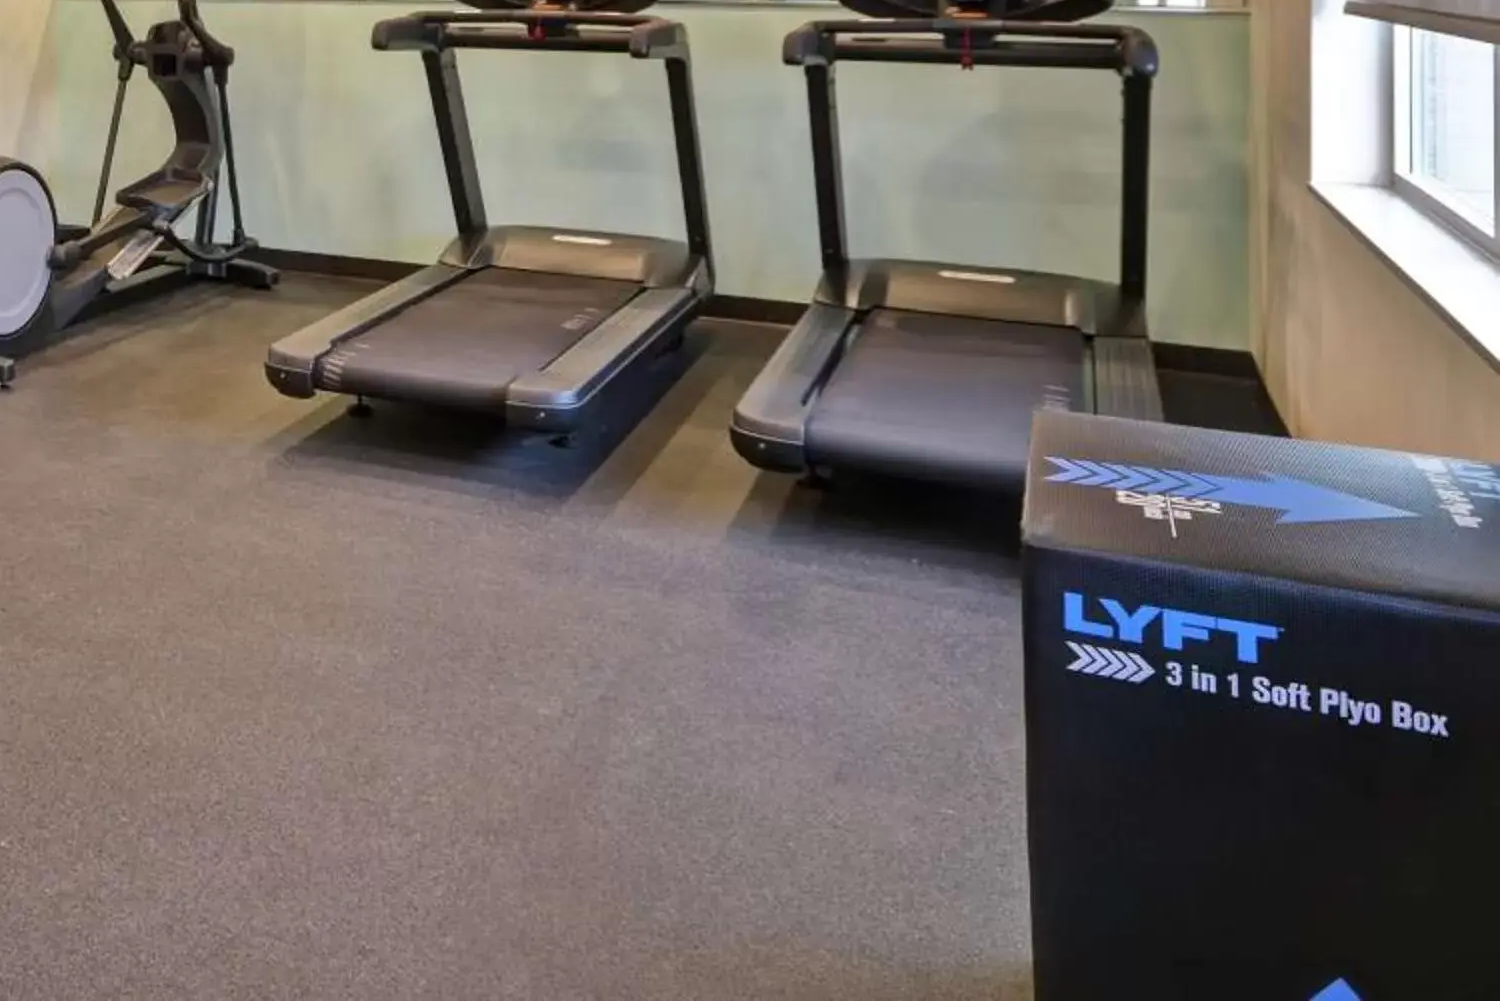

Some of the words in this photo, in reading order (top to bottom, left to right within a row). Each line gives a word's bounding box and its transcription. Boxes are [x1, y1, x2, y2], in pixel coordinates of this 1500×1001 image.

[1063, 591, 1282, 664] LYFT
[1165, 661, 1183, 687] 3
[1190, 664, 1218, 695] in
[1227, 672, 1240, 699] 1
[1251, 675, 1312, 712] Soft
[1319, 686, 1381, 727] Plyo
[1391, 700, 1449, 738] Box
